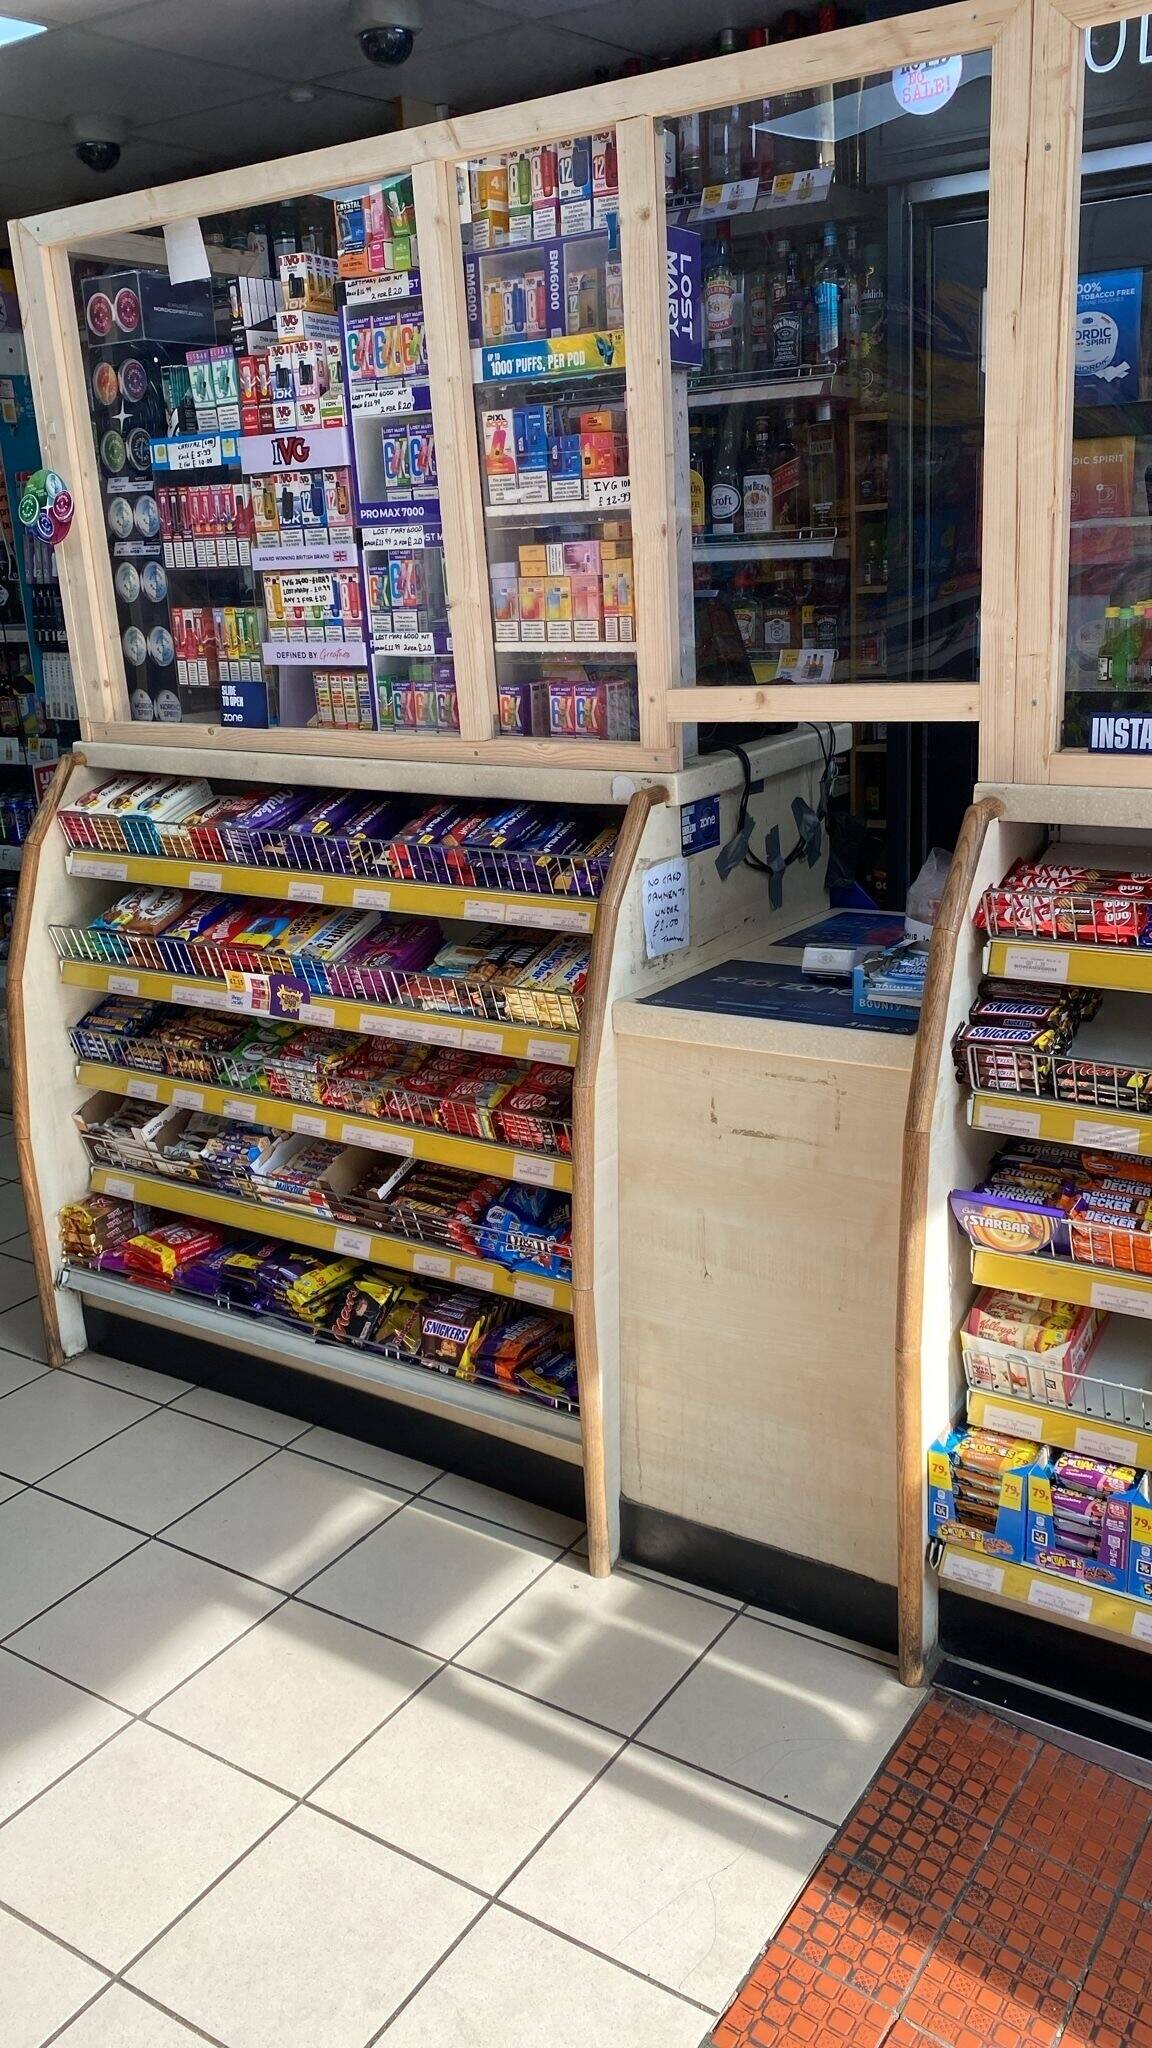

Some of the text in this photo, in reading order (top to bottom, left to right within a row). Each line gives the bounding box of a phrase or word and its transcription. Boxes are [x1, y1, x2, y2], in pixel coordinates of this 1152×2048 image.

[903, 76, 950, 103] SALE!
[560, 157, 572, 184] 12
[593, 155, 605, 180] 12
[336, 200, 361, 211] CRYSTAL
[409, 279, 419, 288] ST
[549, 250, 560, 310] BM6000
[466, 264, 478, 321] BM6000
[667, 250, 679, 338] MARY
[1077, 282, 1101, 293] 00%
[1081, 288, 1135, 300] TOBACCO FREE
[680, 253, 694, 340] LOST
[1075, 327, 1112, 341] ORDIC
[1086, 337, 1111, 346] SPIRIT
[548, 354, 565, 369] PER
[568, 351, 585, 366] POD
[273, 390, 292, 399] 10K
[296, 386, 315, 396] 10K
[272, 436, 311, 465] IVG
[1073, 454, 1125, 466] DIC SPIRIT
[593, 482, 618, 491] IVG
[301, 491, 312, 512] 12
[326, 489, 336, 510] 12
[360, 507, 424, 519] PRO MAX 7000
[222, 686, 236, 696] SLIDE
[222, 696, 244, 707] TO OPEN
[223, 713, 243, 722] zone
[252, 788, 294, 818] Milka
[700, 816, 715, 828] zone
[648, 872, 681, 888] NO CARD
[654, 905, 679, 917] UNDER
[1105, 912, 1130, 922] DUO
[317, 909, 369, 949] HERSHEY'S
[860, 999, 901, 1010] BOUNTY
[984, 1002, 1048, 1016] SNICKERS
[971, 1027, 1036, 1041] SNICKERS
[455, 1082, 485, 1094] KitKat
[511, 1095, 547, 1109] KitKat
[1019, 1144, 1079, 1158] STARBAR
[1001, 1167, 1063, 1184] STARBAR
[275, 1181, 305, 1194] Milkybar
[1103, 1179, 1151, 1196] DECKER
[984, 1188, 1045, 1205] STARBAR
[1082, 1193, 1132, 1212] DECKER
[969, 1215, 1031, 1235] STARBAR
[1086, 1210, 1137, 1229] DECKER
[423, 1321, 469, 1342] SNICKERS
[979, 1319, 1017, 1336] Kellogg's
[931, 1464, 948, 1476] 79p
[1004, 1483, 1020, 1497] 79p
[1032, 1487, 1049, 1500] 79p
